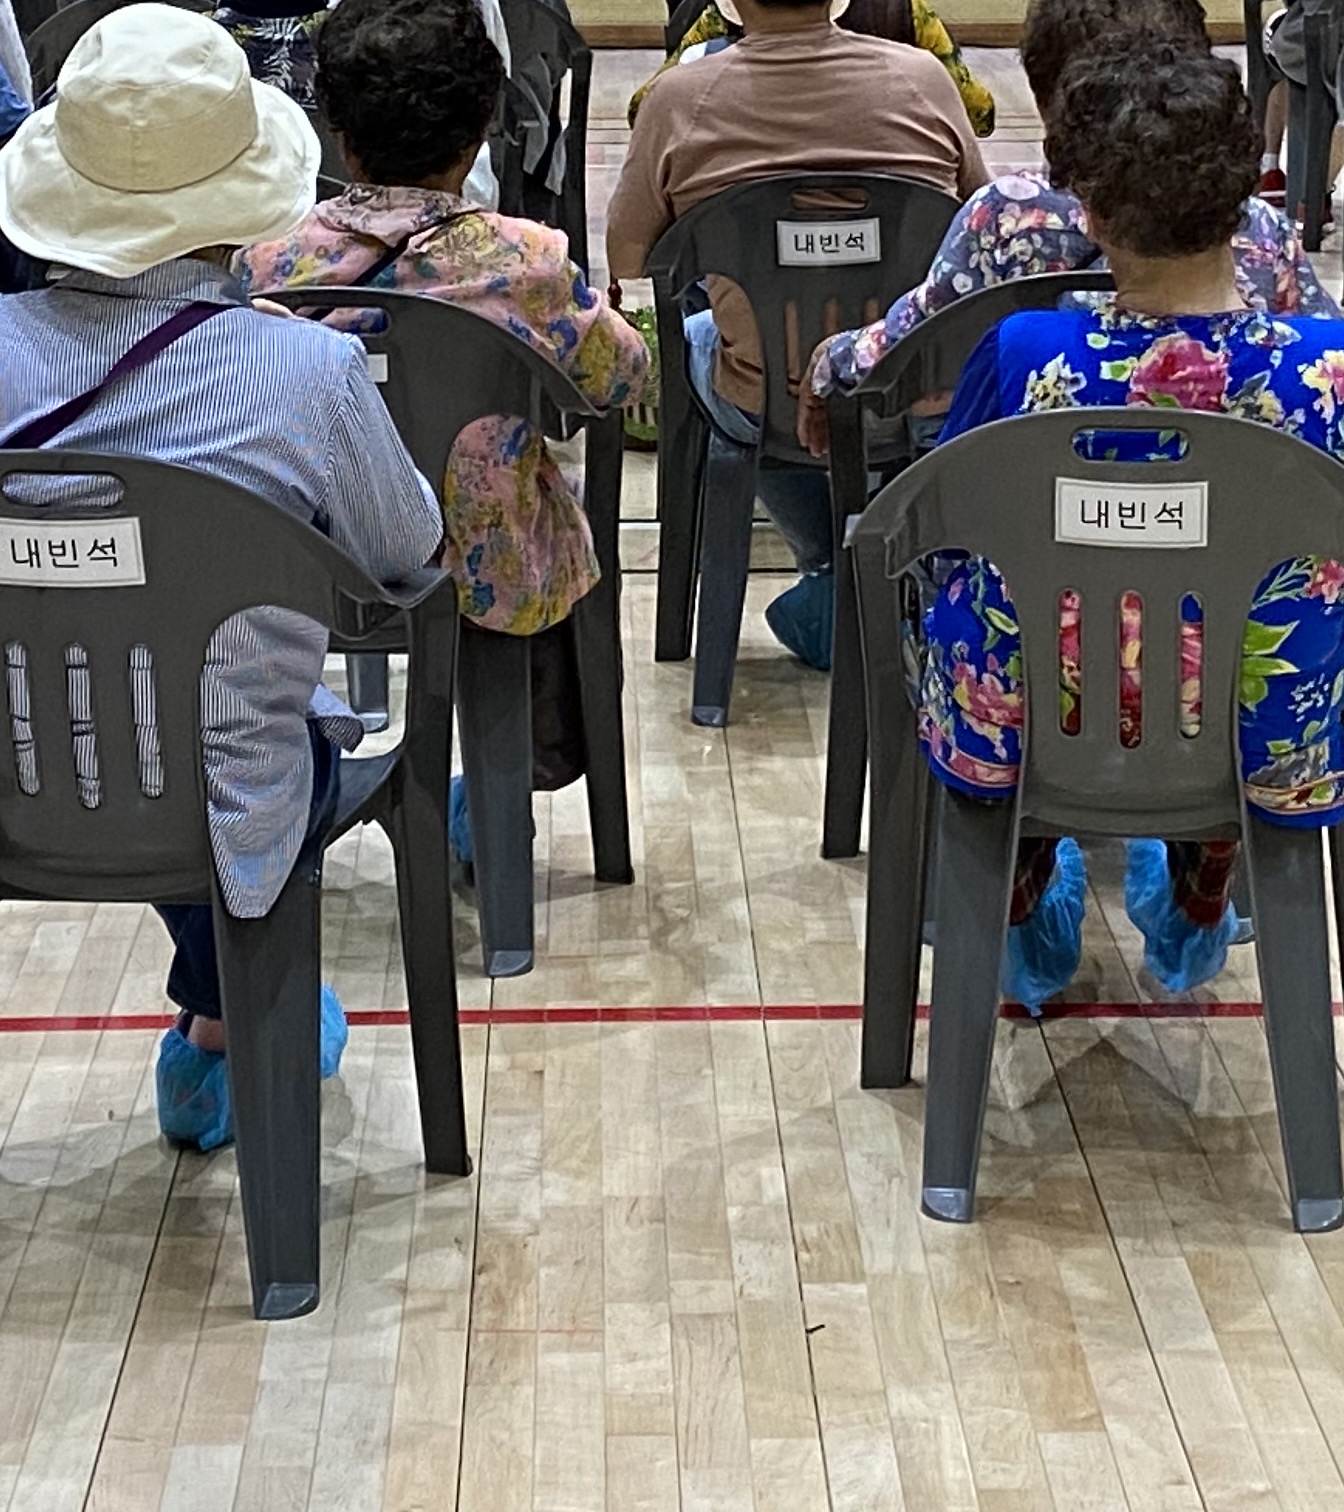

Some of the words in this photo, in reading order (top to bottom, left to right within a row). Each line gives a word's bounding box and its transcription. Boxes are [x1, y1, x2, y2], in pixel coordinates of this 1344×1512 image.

[794, 231, 865, 254] 내빈석
[1081, 499, 1184, 530] 내빈석
[10, 537, 118, 568] 내빈석
